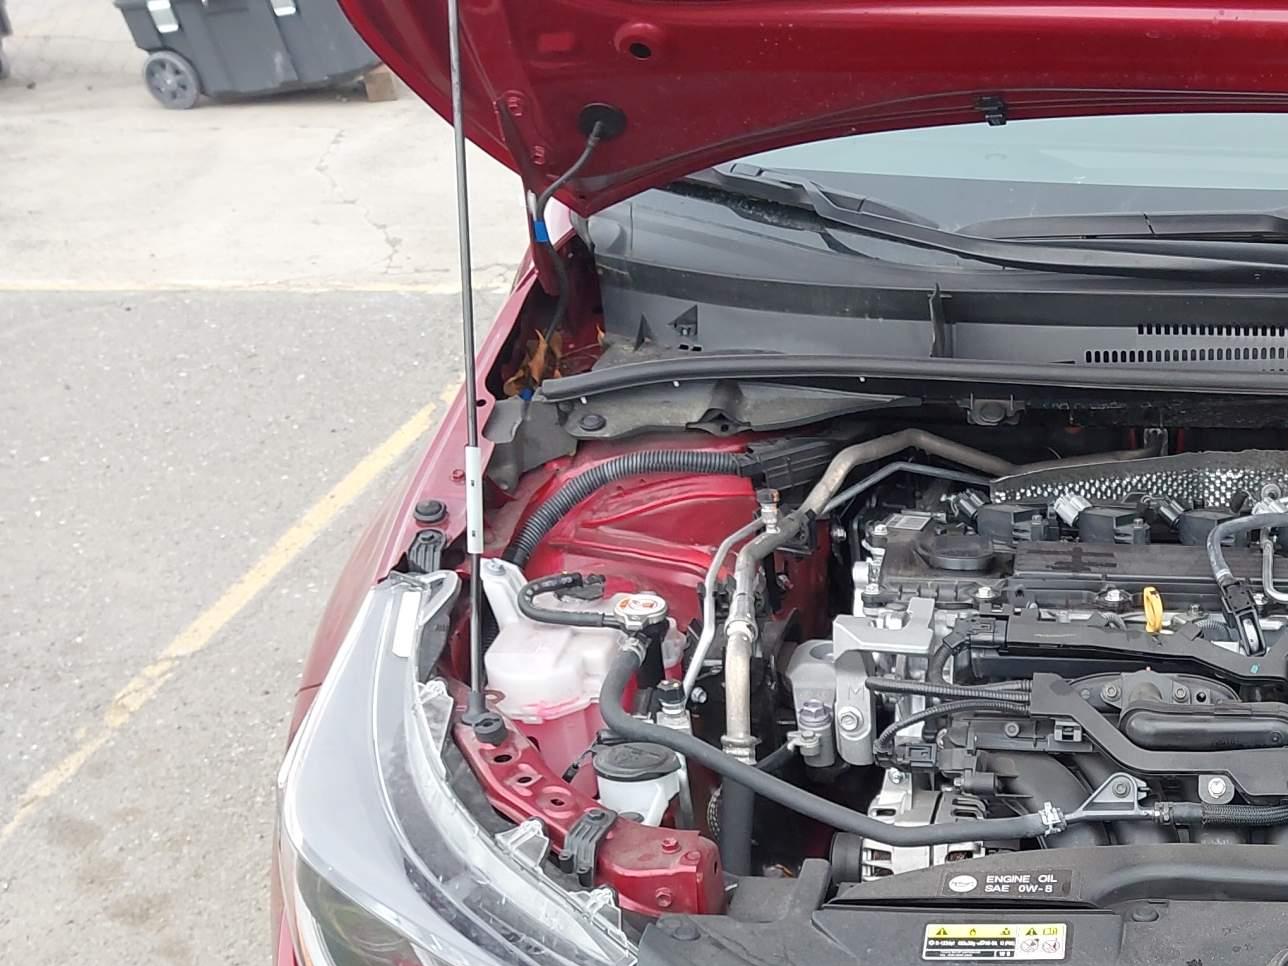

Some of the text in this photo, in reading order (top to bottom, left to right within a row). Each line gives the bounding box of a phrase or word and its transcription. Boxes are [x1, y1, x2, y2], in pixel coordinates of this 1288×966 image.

[986, 874, 1058, 884] ENGINE OIL
[984, 884, 1010, 893] SAE
